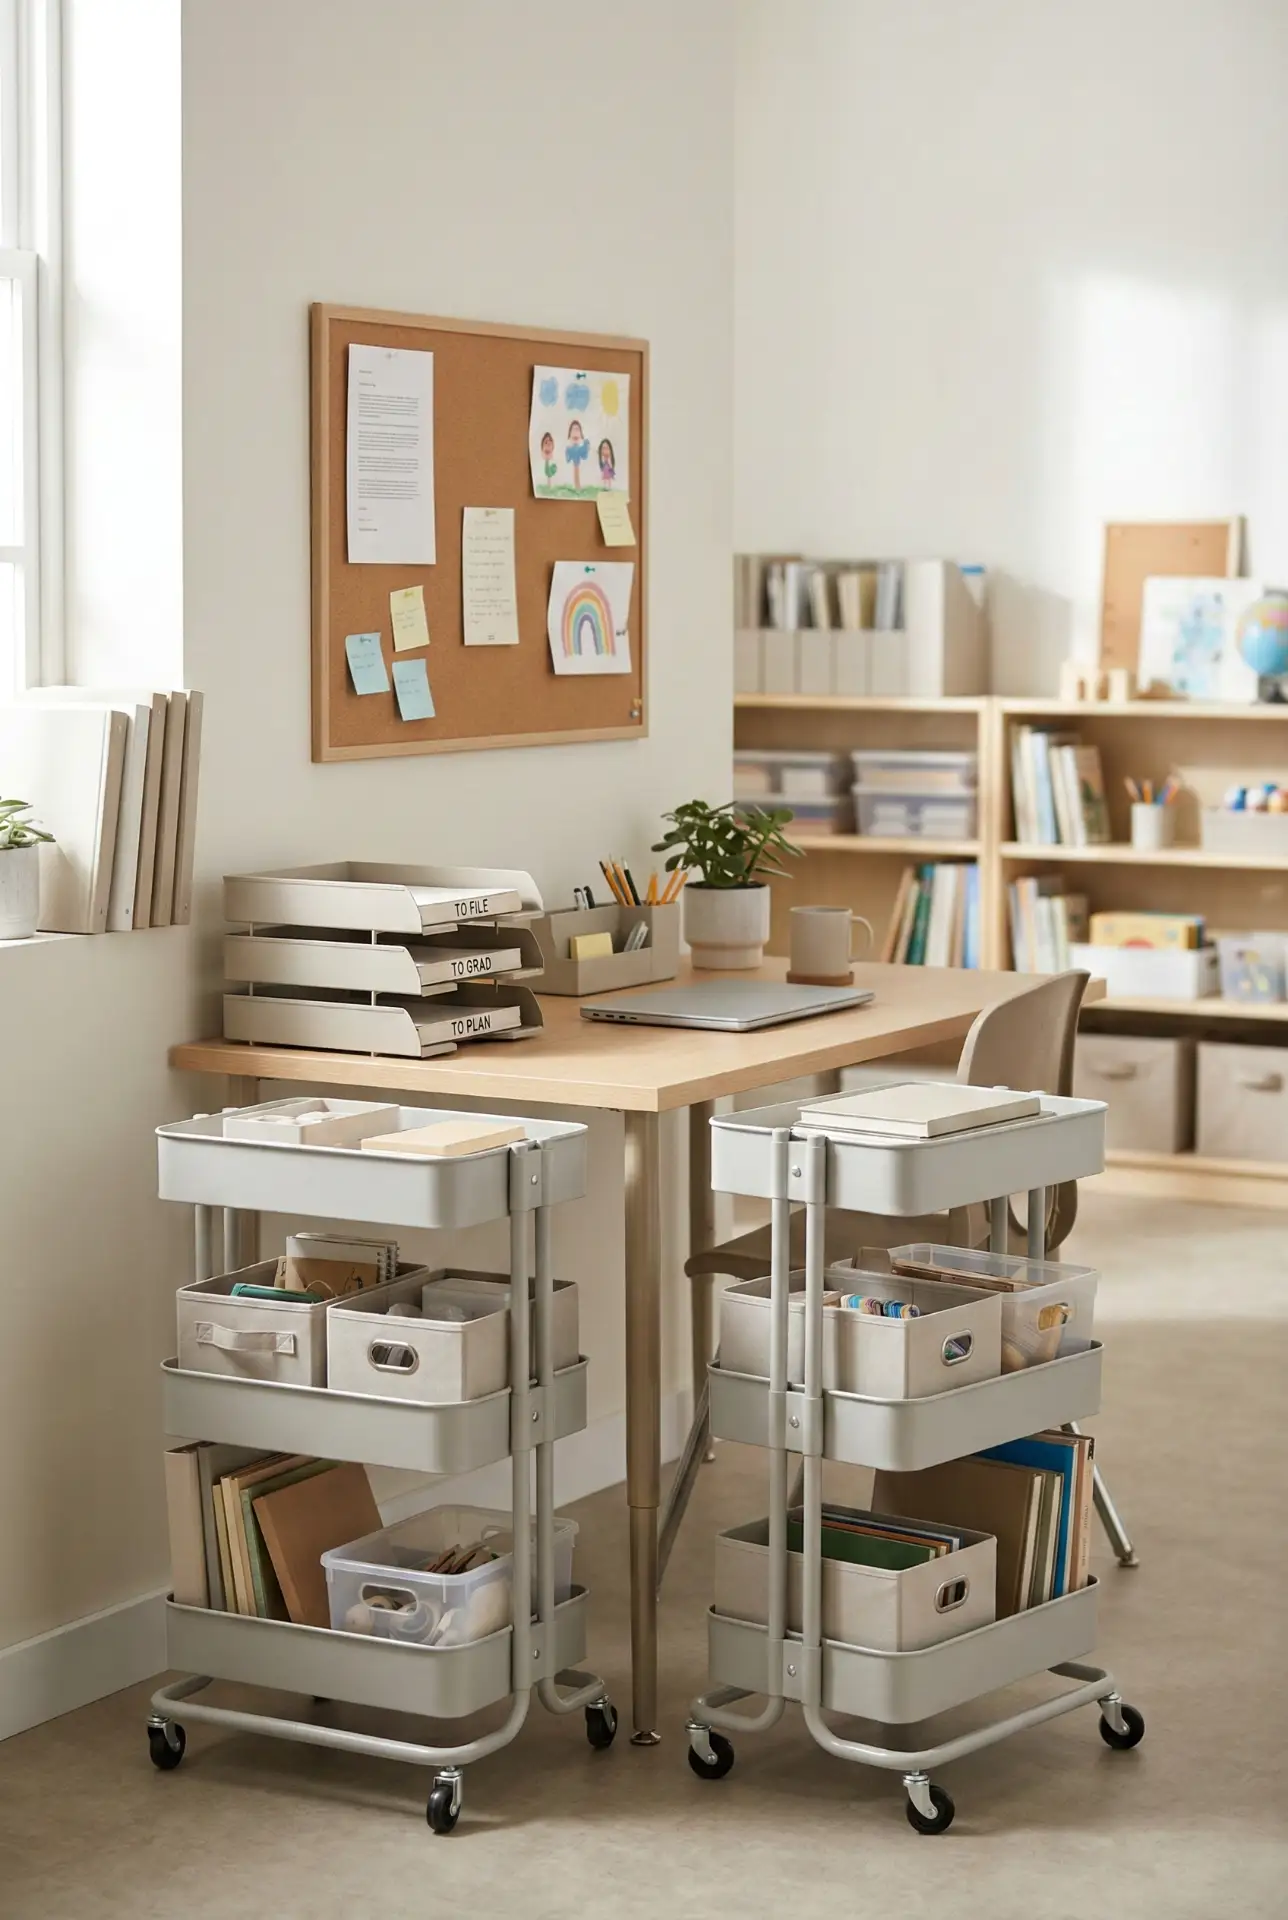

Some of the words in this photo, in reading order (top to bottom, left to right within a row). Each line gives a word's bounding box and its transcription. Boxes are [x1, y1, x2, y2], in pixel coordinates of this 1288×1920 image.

[455, 902, 467, 917] TO
[469, 899, 489, 915] FILE
[451, 961, 464, 976] TO
[466, 957, 492, 973] GRAD
[451, 1020, 464, 1036] TO
[466, 1014, 491, 1033] PLAN
